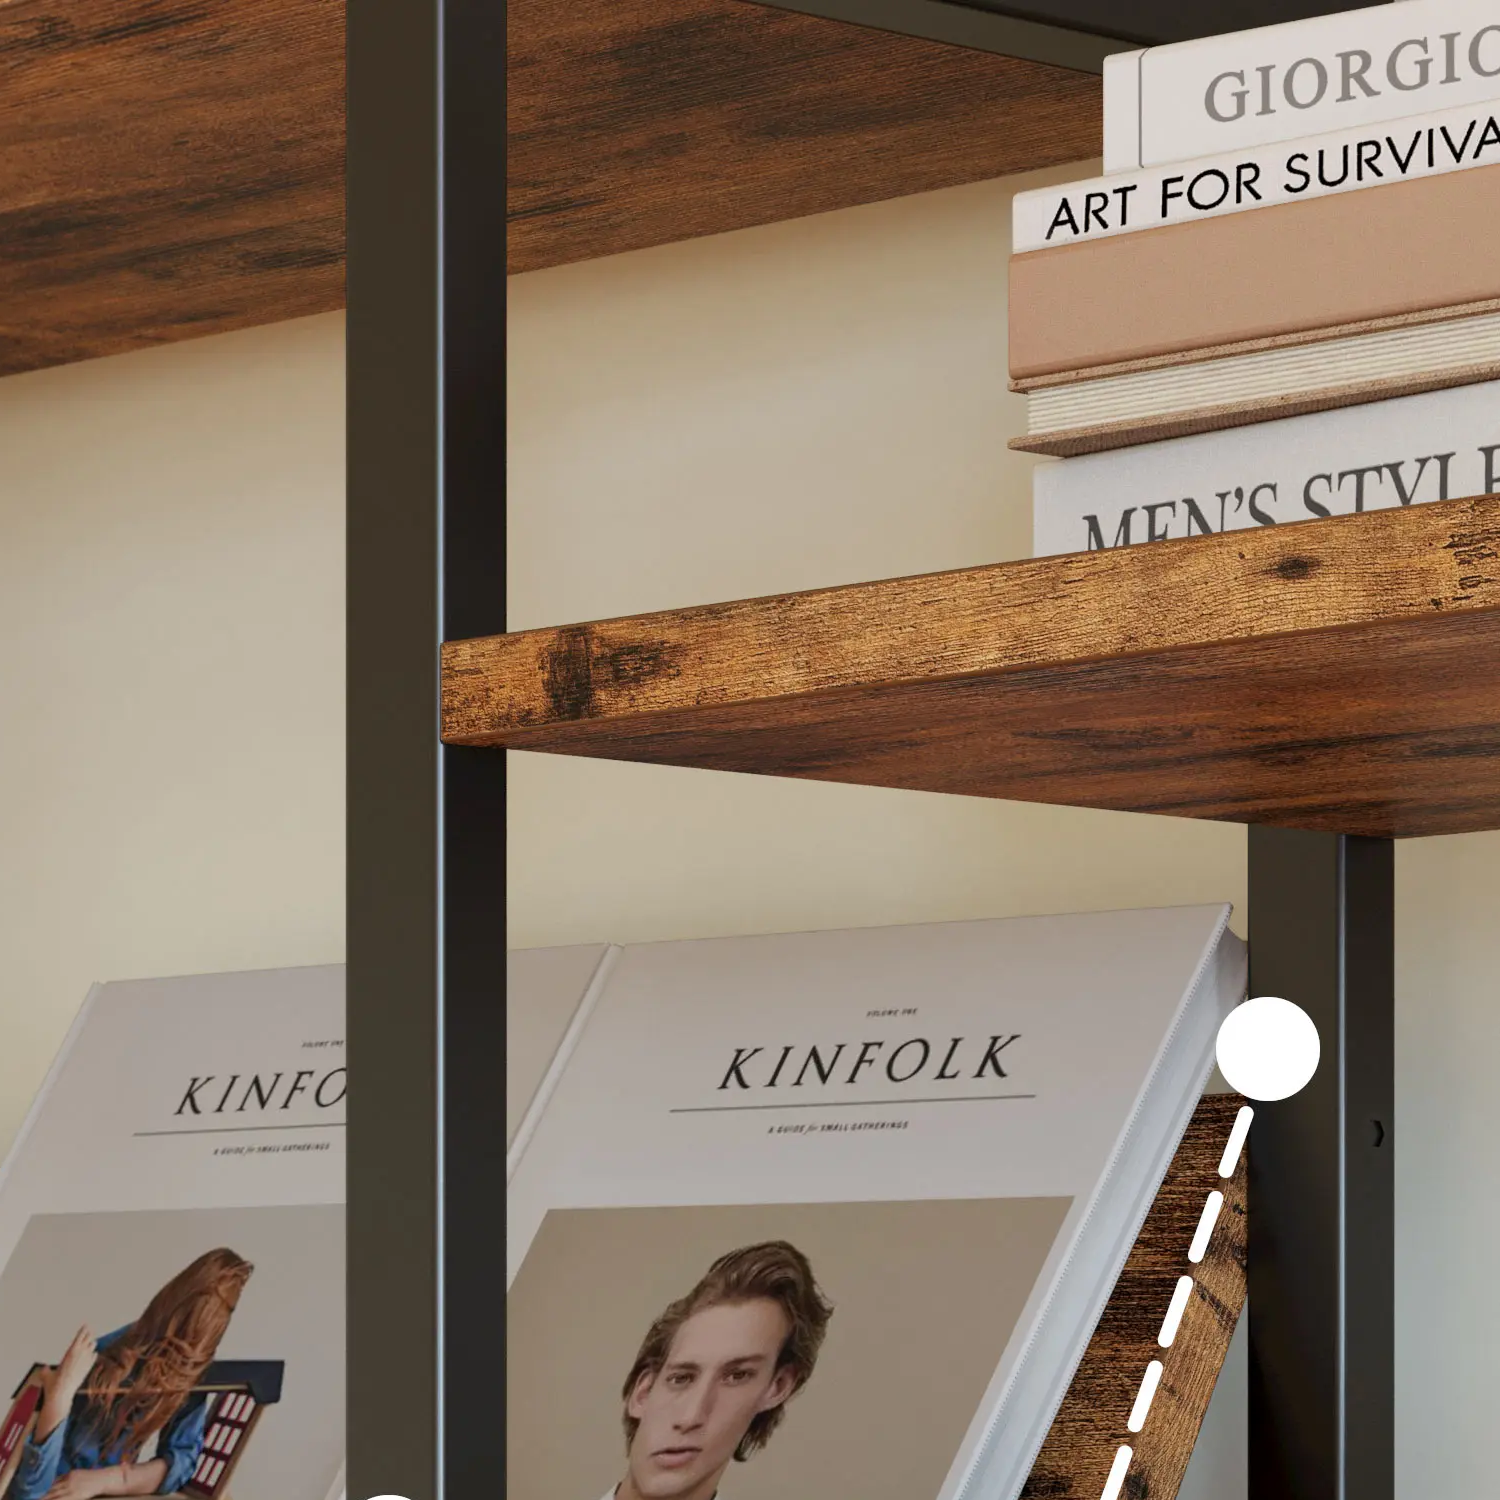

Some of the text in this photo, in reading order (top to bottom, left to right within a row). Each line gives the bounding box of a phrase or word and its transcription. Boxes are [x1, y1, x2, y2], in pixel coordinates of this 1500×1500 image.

[1045, 184, 1138, 240] ART
[1160, 162, 1262, 218] FOR
[716, 1033, 1022, 1091] KINFOLK
[173, 1067, 347, 1116] KINFO
